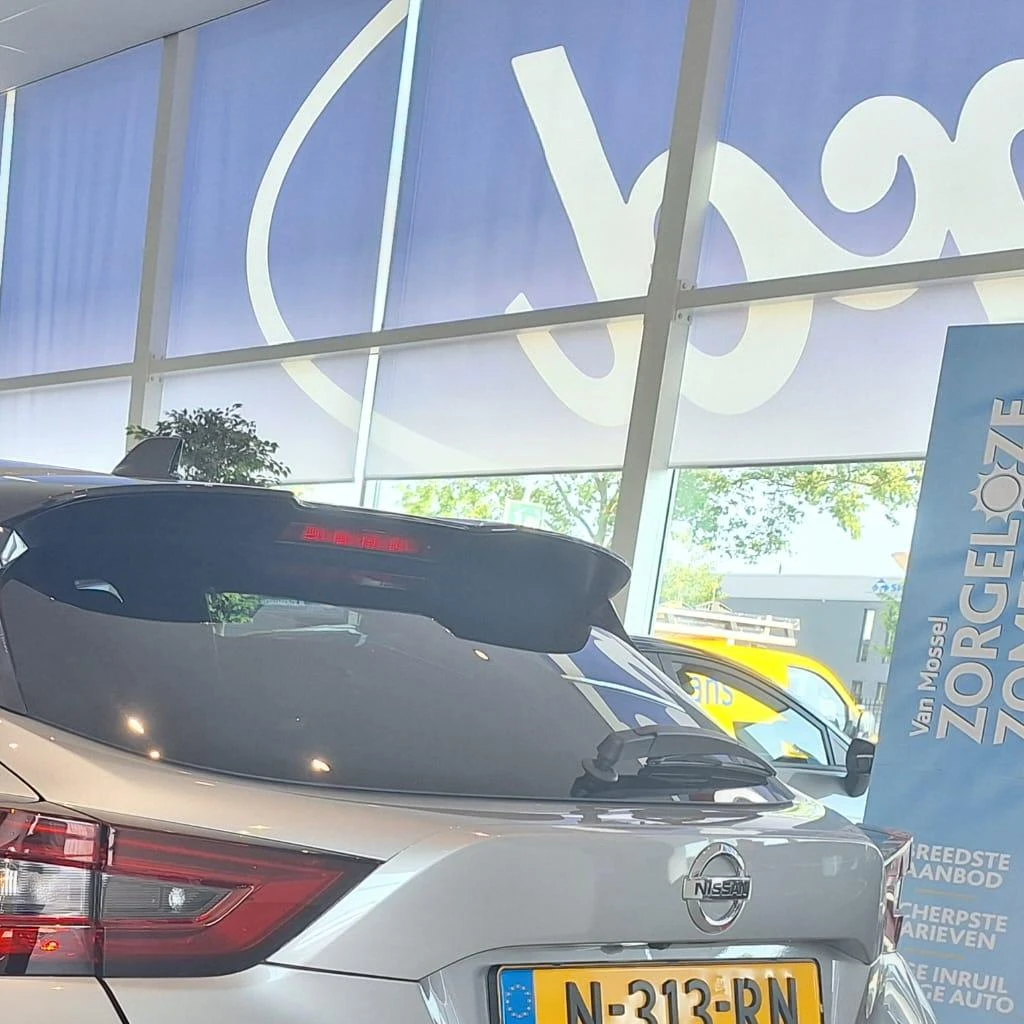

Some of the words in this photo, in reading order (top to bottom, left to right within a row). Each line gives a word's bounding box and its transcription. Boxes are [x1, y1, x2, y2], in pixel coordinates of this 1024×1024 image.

[917, 615, 950, 692] Mossel
[909, 695, 934, 737] Van
[694, 880, 749, 897] NISSAN
[900, 902, 1009, 933] CHERPSTE
[901, 921, 997, 950] ARIEVEN
[932, 966, 1009, 994] INRUIL
[948, 988, 1015, 1014] AUTO
